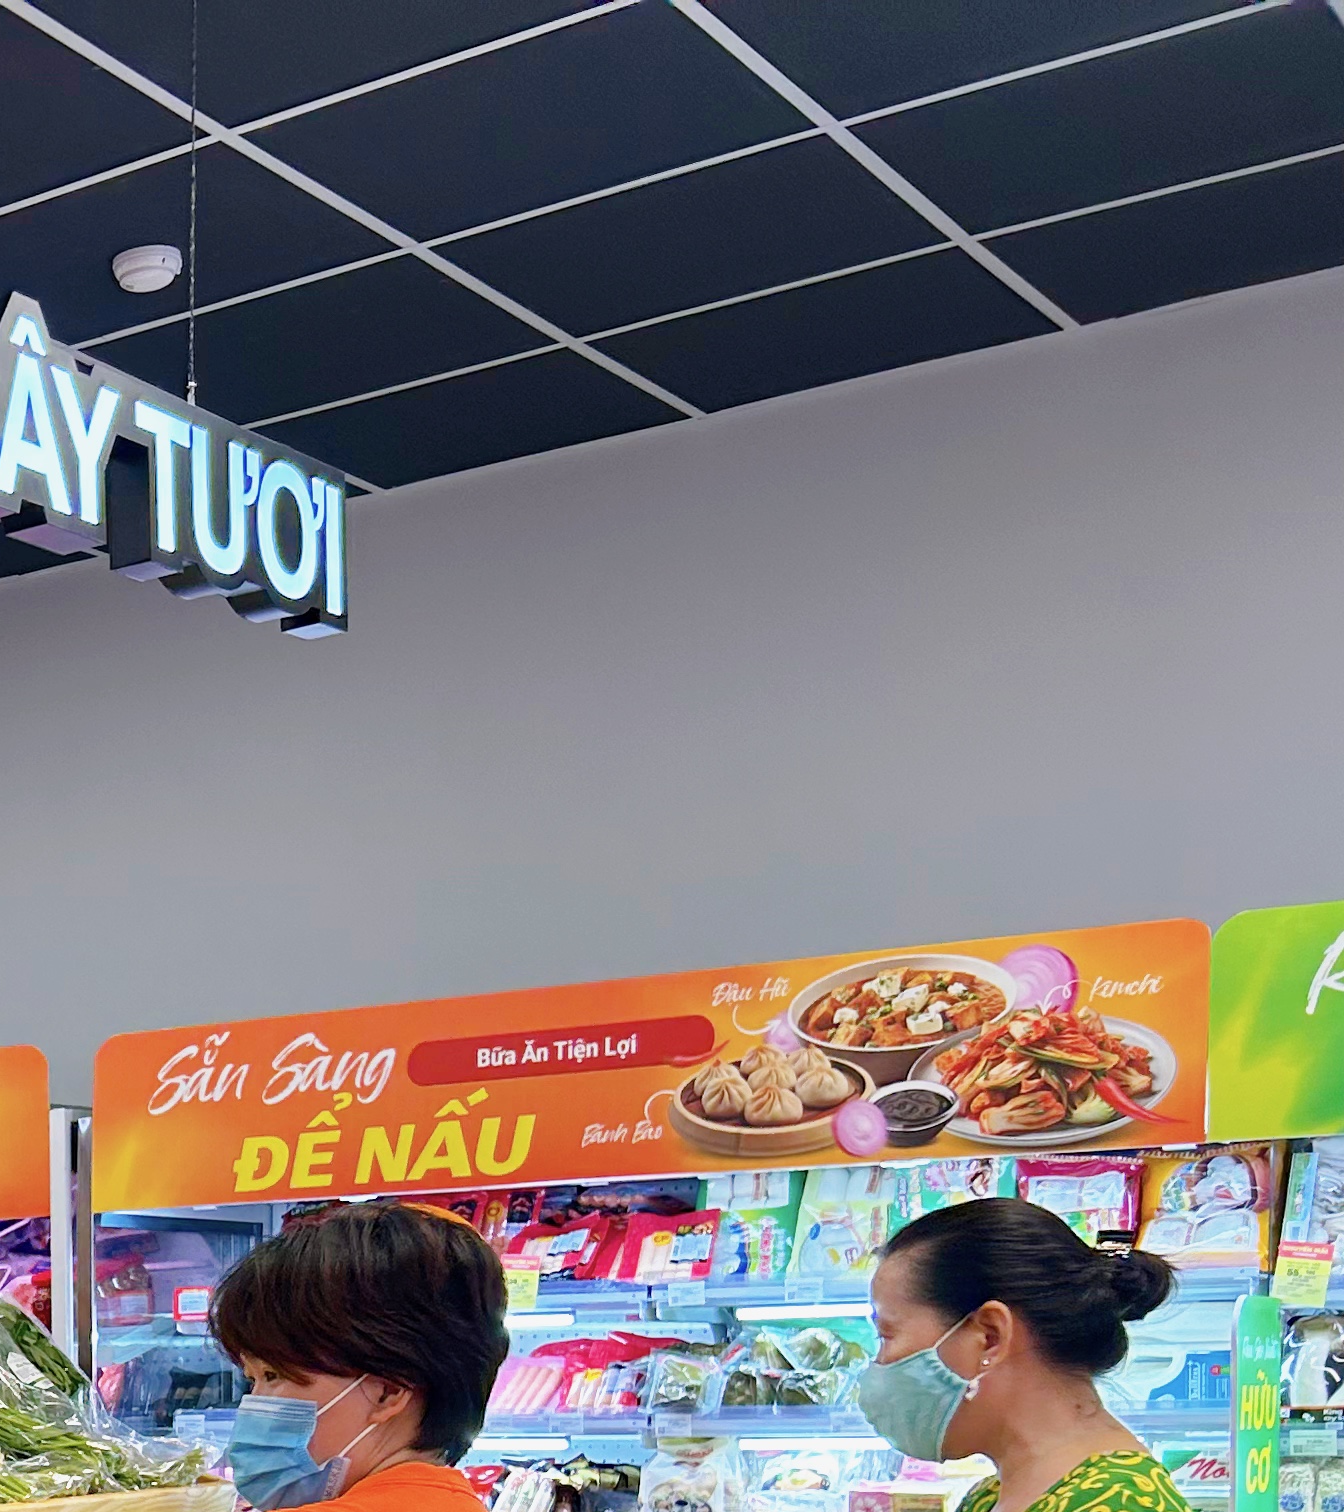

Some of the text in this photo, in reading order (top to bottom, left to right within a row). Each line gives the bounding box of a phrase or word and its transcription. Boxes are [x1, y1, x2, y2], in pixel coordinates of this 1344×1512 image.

[134, 400, 348, 619] TƯƠI
[148, 1030, 397, 1116] Sẵn Sàng
[475, 1032, 639, 1069] Bữa Ăn Tiện Lợi
[231, 1087, 537, 1193] ĐỂ NẤU
